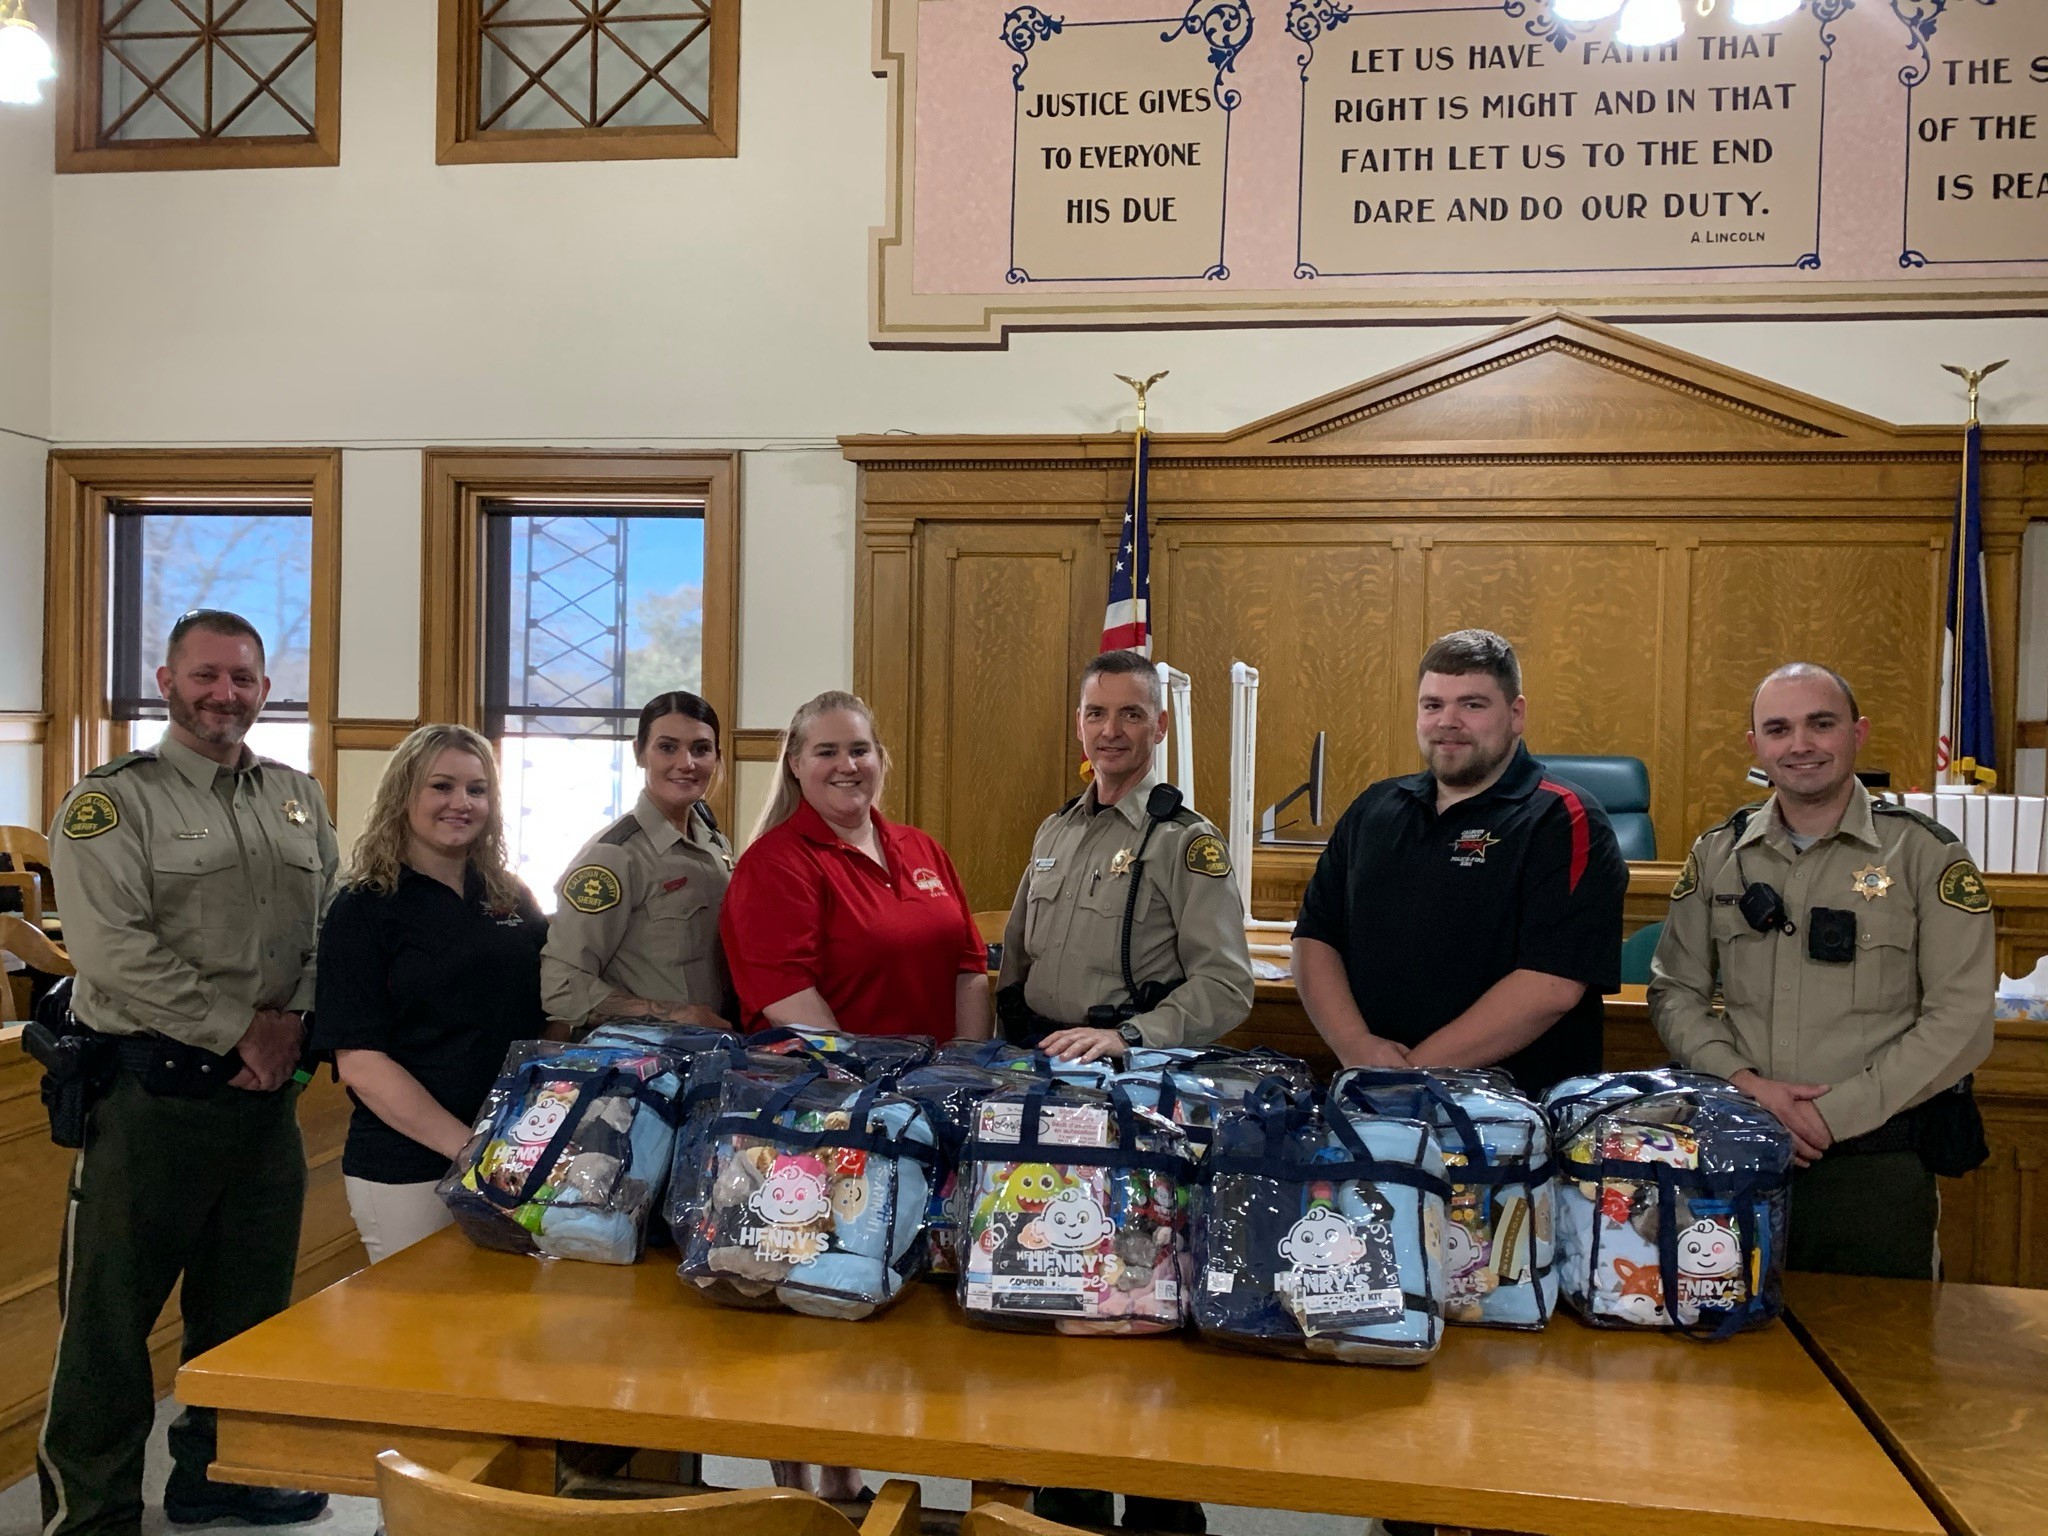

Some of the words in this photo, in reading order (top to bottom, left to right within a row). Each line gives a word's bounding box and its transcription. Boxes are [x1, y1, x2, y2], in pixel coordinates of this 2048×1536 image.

[1351, 48, 1405, 74] LET
[1415, 46, 1455, 72] US
[1468, 43, 1545, 71] HAVE
[1697, 32, 1782, 61] THAT
[1942, 57, 2013, 86] THE
[1025, 90, 1130, 119] JUSTICE
[1138, 87, 1212, 115] GIVES
[1334, 96, 1429, 124] RIGHT
[1438, 95, 1469, 120] IS
[1482, 91, 1579, 119] MIGHT
[1594, 89, 1657, 116] AND
[1667, 88, 1695, 114] IN
[1707, 82, 1797, 112] THAT
[1917, 117, 1960, 143] OF
[1969, 114, 2038, 141] THE
[1040, 146, 1072, 170] TO
[1079, 141, 1202, 170] EVERYONE
[1341, 147, 1434, 174] FAITH
[1448, 144, 1510, 171] LET
[1522, 143, 1566, 170] US
[1581, 142, 1625, 168] TO
[1636, 140, 1699, 167] THE
[1712, 137, 1773, 165] END
[1937, 173, 1974, 202] IS
[1066, 198, 1111, 225] HIS
[1122, 196, 1178, 224] DUE
[1353, 198, 1436, 225] DARE
[1446, 197, 1509, 223] AND
[1520, 195, 1563, 221] DO
[1581, 192, 1648, 222] OUR
[1663, 190, 1770, 219] DUTY.
[1705, 230, 1766, 244] LINCOLN
[739, 1226, 830, 1251] HENRY'S
[1502, 1202, 1527, 1274] SIMPLICITY
[753, 1241, 821, 1269] Heroes
[1009, 1277, 1046, 1288] COMFOR
